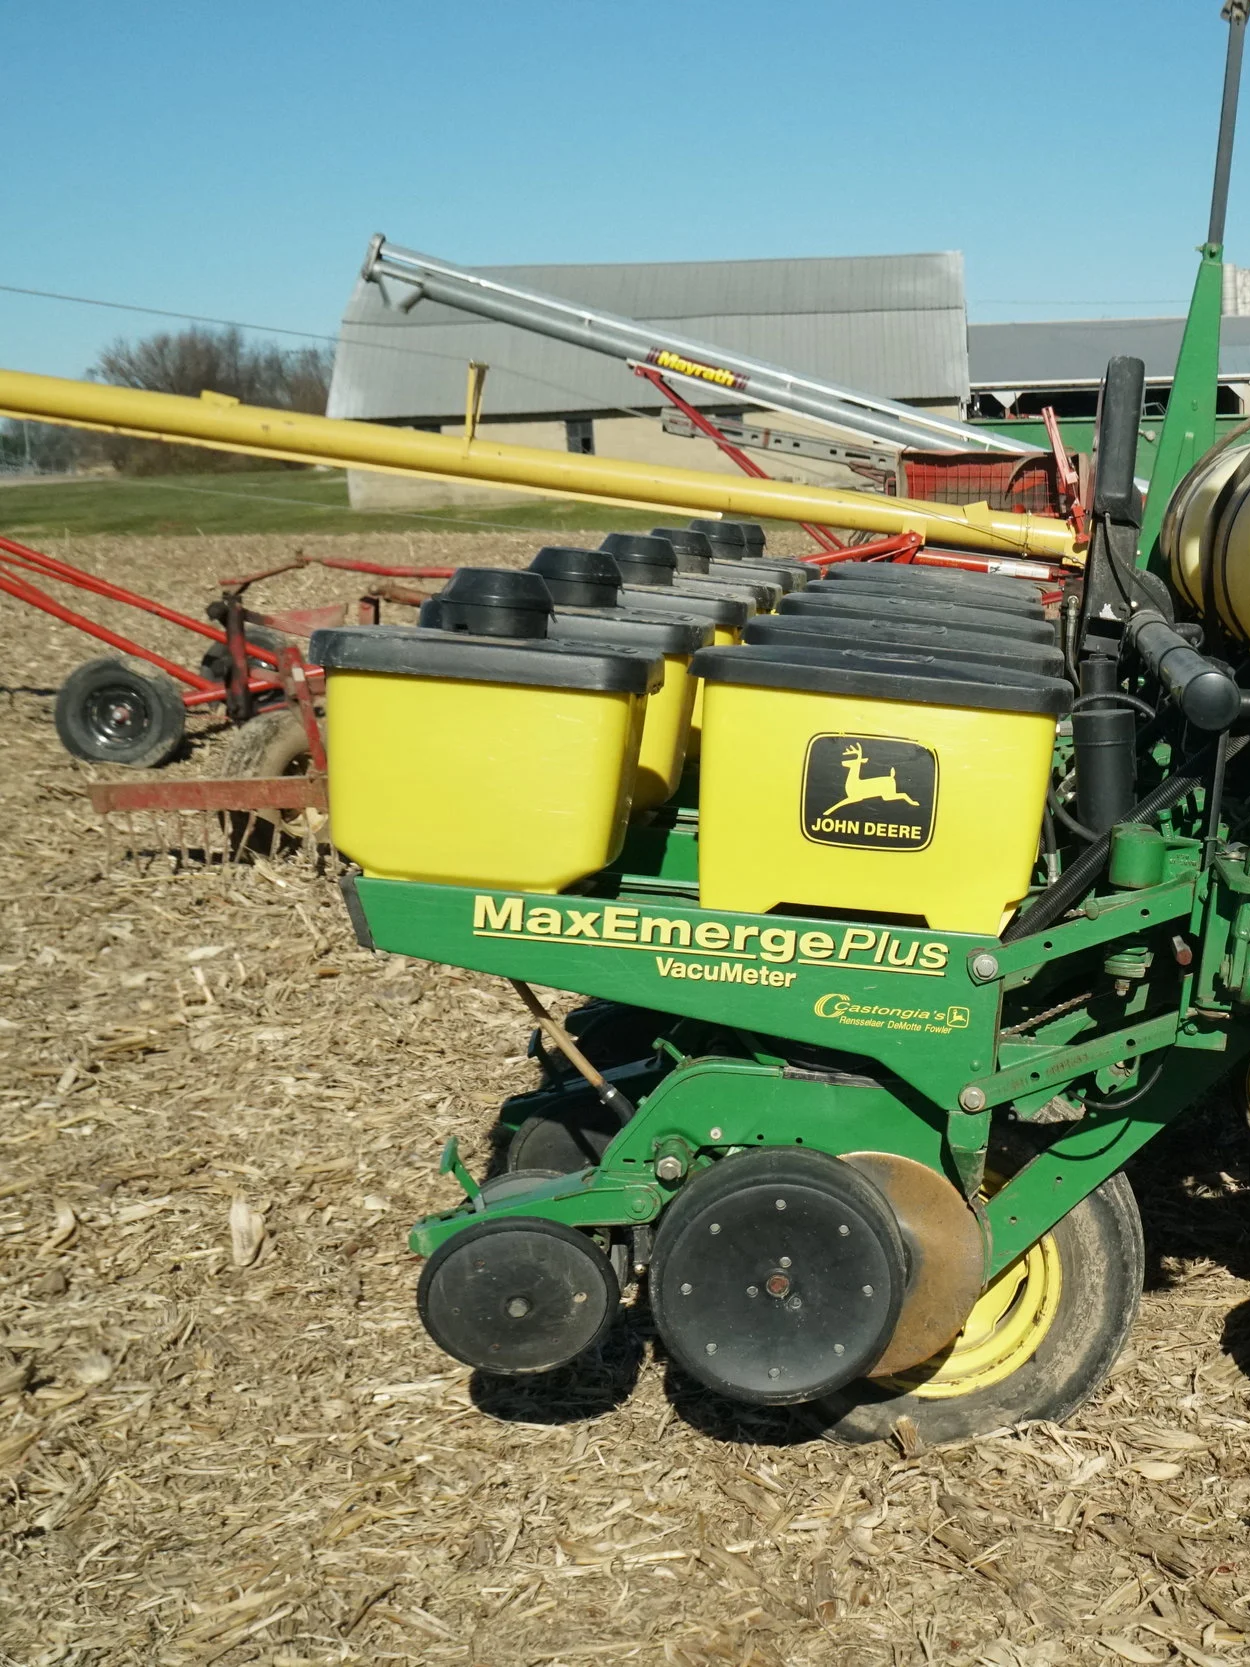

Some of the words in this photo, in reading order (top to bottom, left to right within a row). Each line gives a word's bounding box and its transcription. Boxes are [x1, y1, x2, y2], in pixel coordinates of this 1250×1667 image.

[657, 351, 735, 387] Mayrath
[811, 818, 860, 835] JOHN
[864, 822, 922, 840] DEERE
[655, 956, 797, 988] VacuMeter
[839, 1016, 885, 1028] Rensselaer
[887, 1020, 922, 1032] DeMotte
[925, 1023, 953, 1035] Fowler
